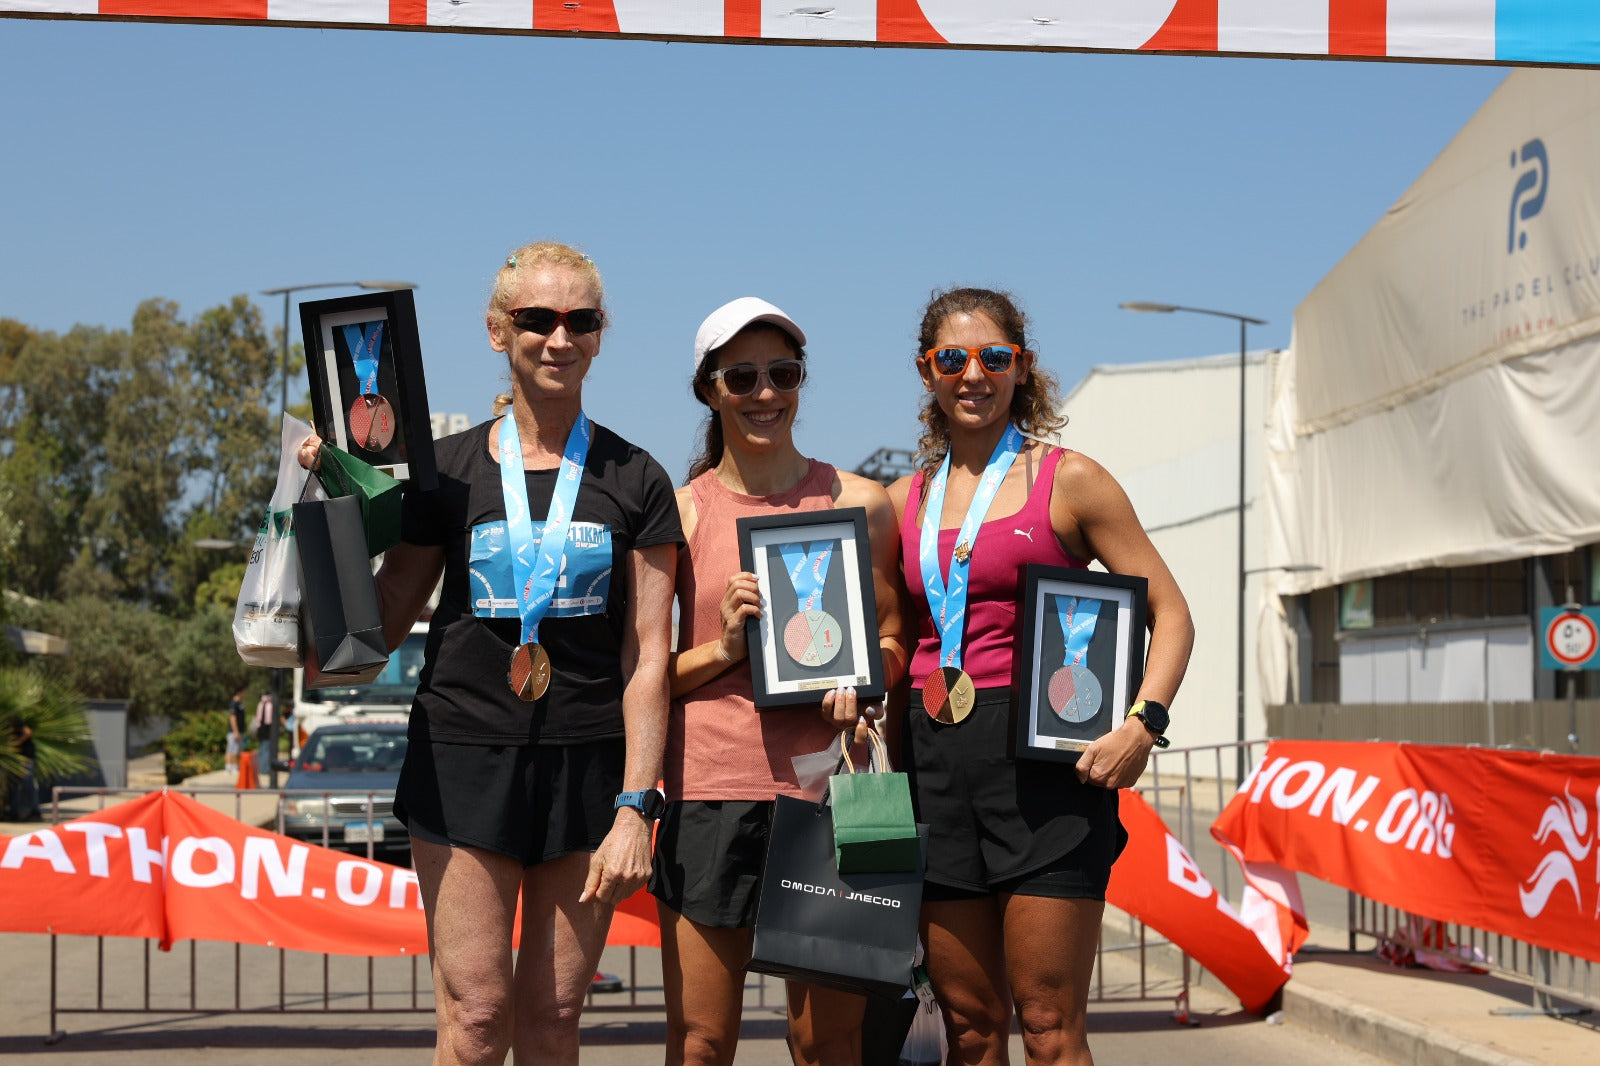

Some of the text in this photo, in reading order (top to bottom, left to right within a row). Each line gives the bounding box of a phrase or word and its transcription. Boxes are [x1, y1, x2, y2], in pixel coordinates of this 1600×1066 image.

[1493, 276, 1554, 310] PADEL
[781, 879, 901, 908] OMODA JAECOO
